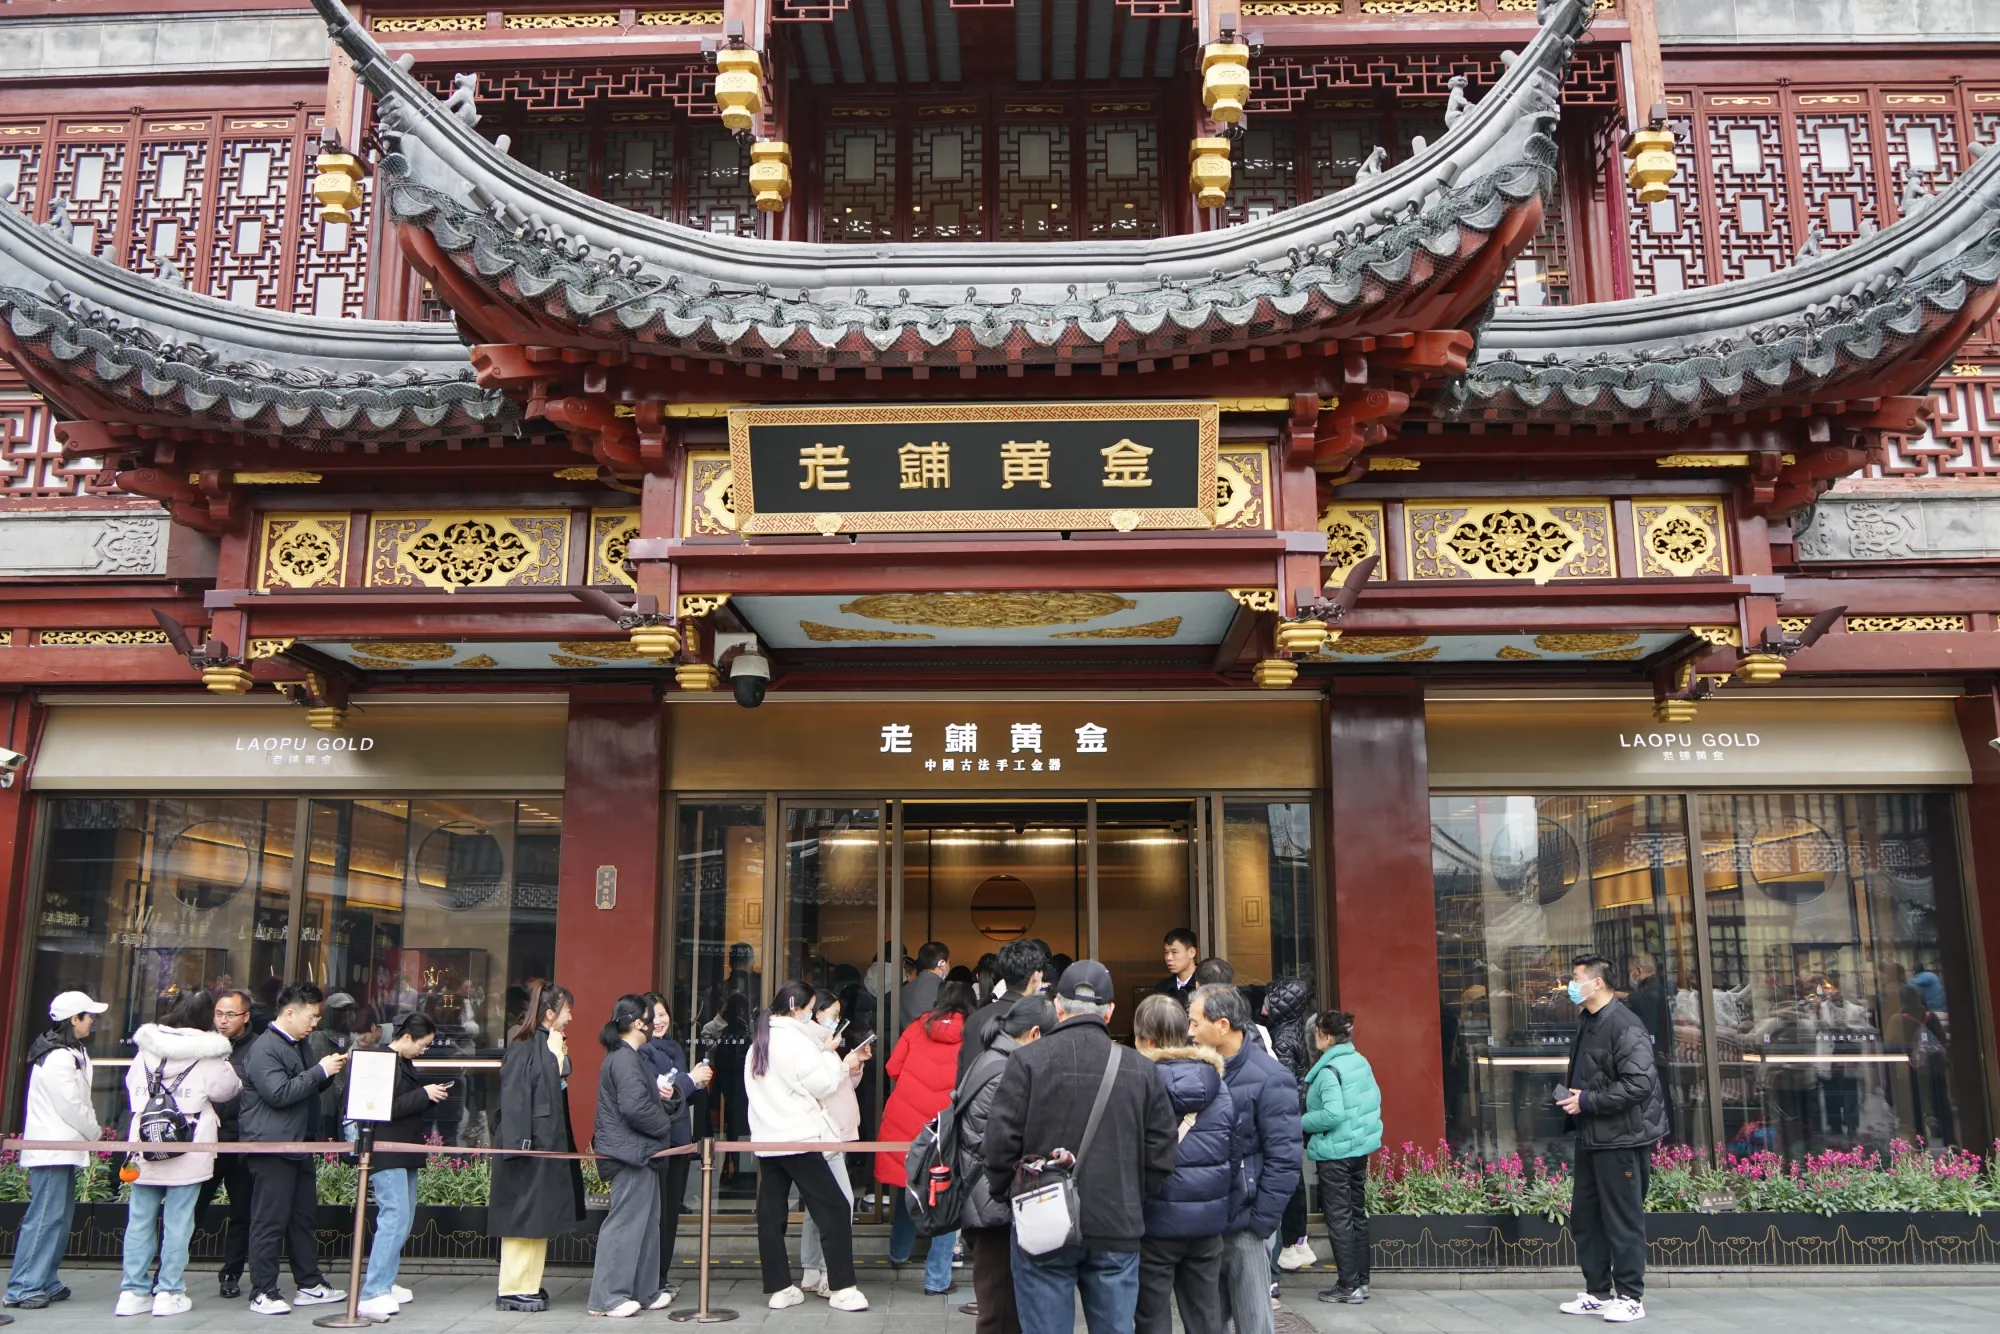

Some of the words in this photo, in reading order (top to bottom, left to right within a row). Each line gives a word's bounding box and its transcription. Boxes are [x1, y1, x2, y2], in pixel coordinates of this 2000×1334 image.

[235, 737, 307, 751] LAOPU
[316, 737, 374, 751] GOLD
[1619, 733, 1692, 747] LAOPU
[1702, 733, 1760, 747] GOLD
[924, 758, 1062, 772] 中國古法手工金器
